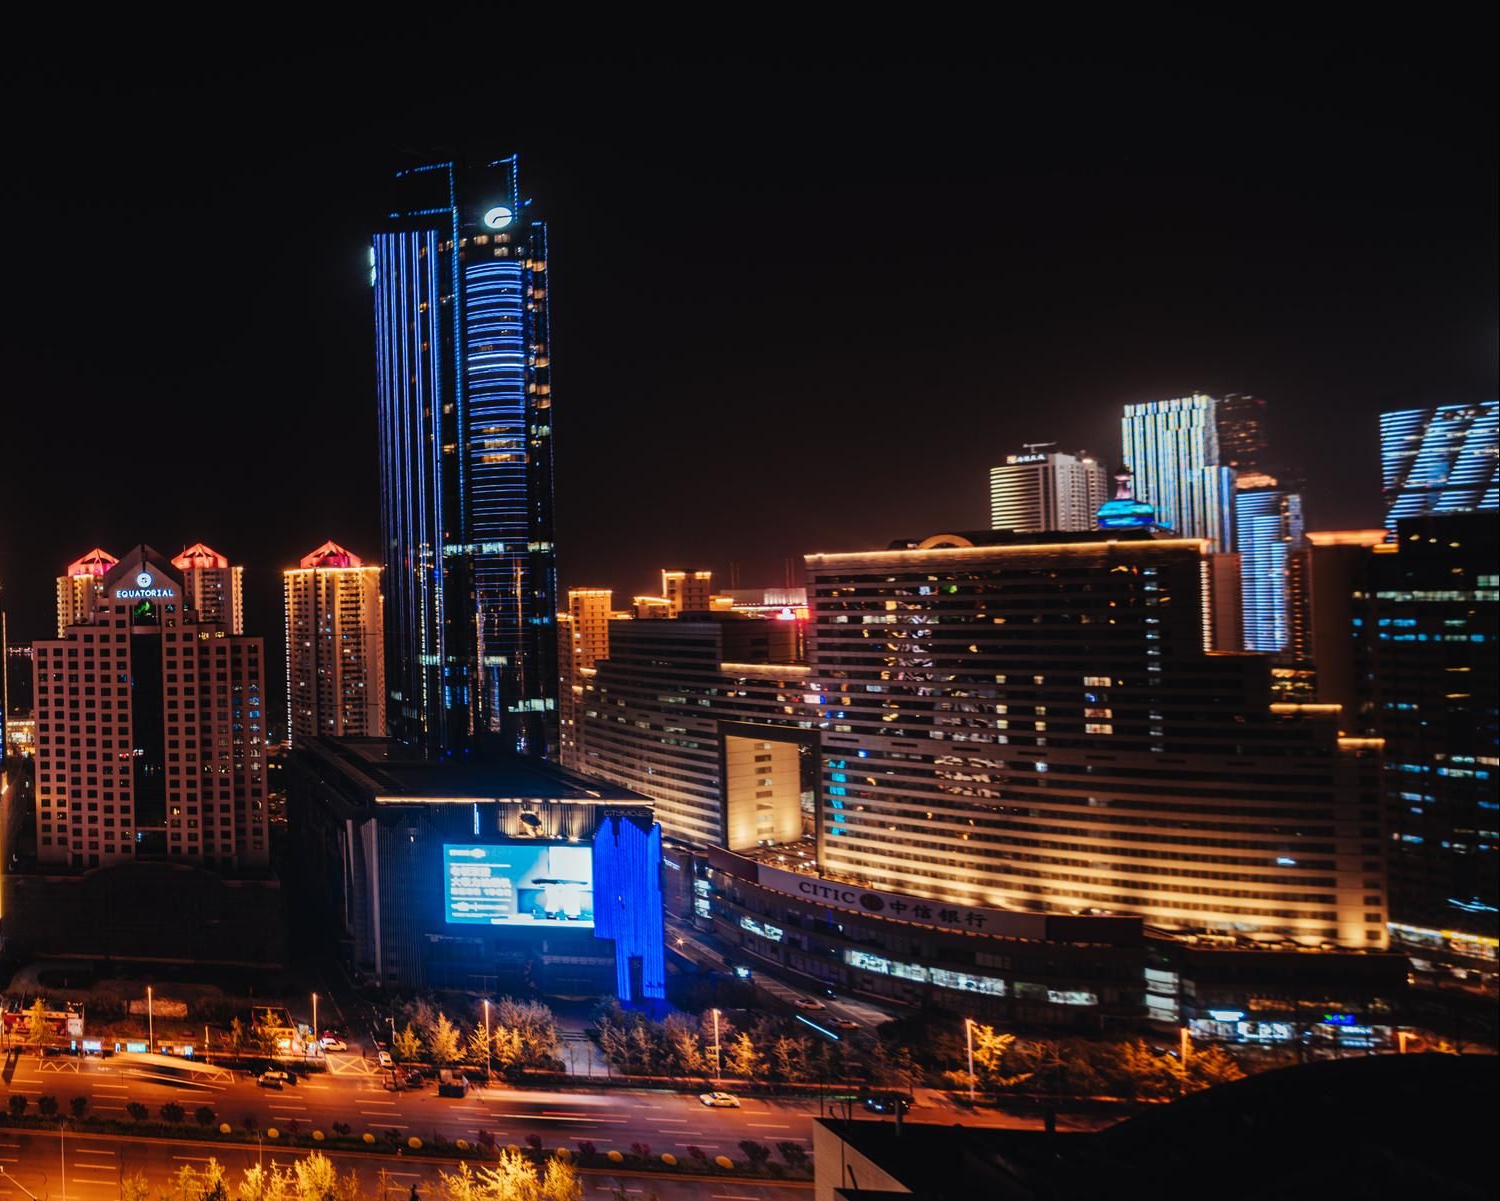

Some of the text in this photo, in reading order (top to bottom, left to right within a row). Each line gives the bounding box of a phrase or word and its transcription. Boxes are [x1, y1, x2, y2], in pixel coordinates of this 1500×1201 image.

[116, 589, 174, 598] EQUATORIAL
[798, 881, 988, 928] CITIC 中信银行
